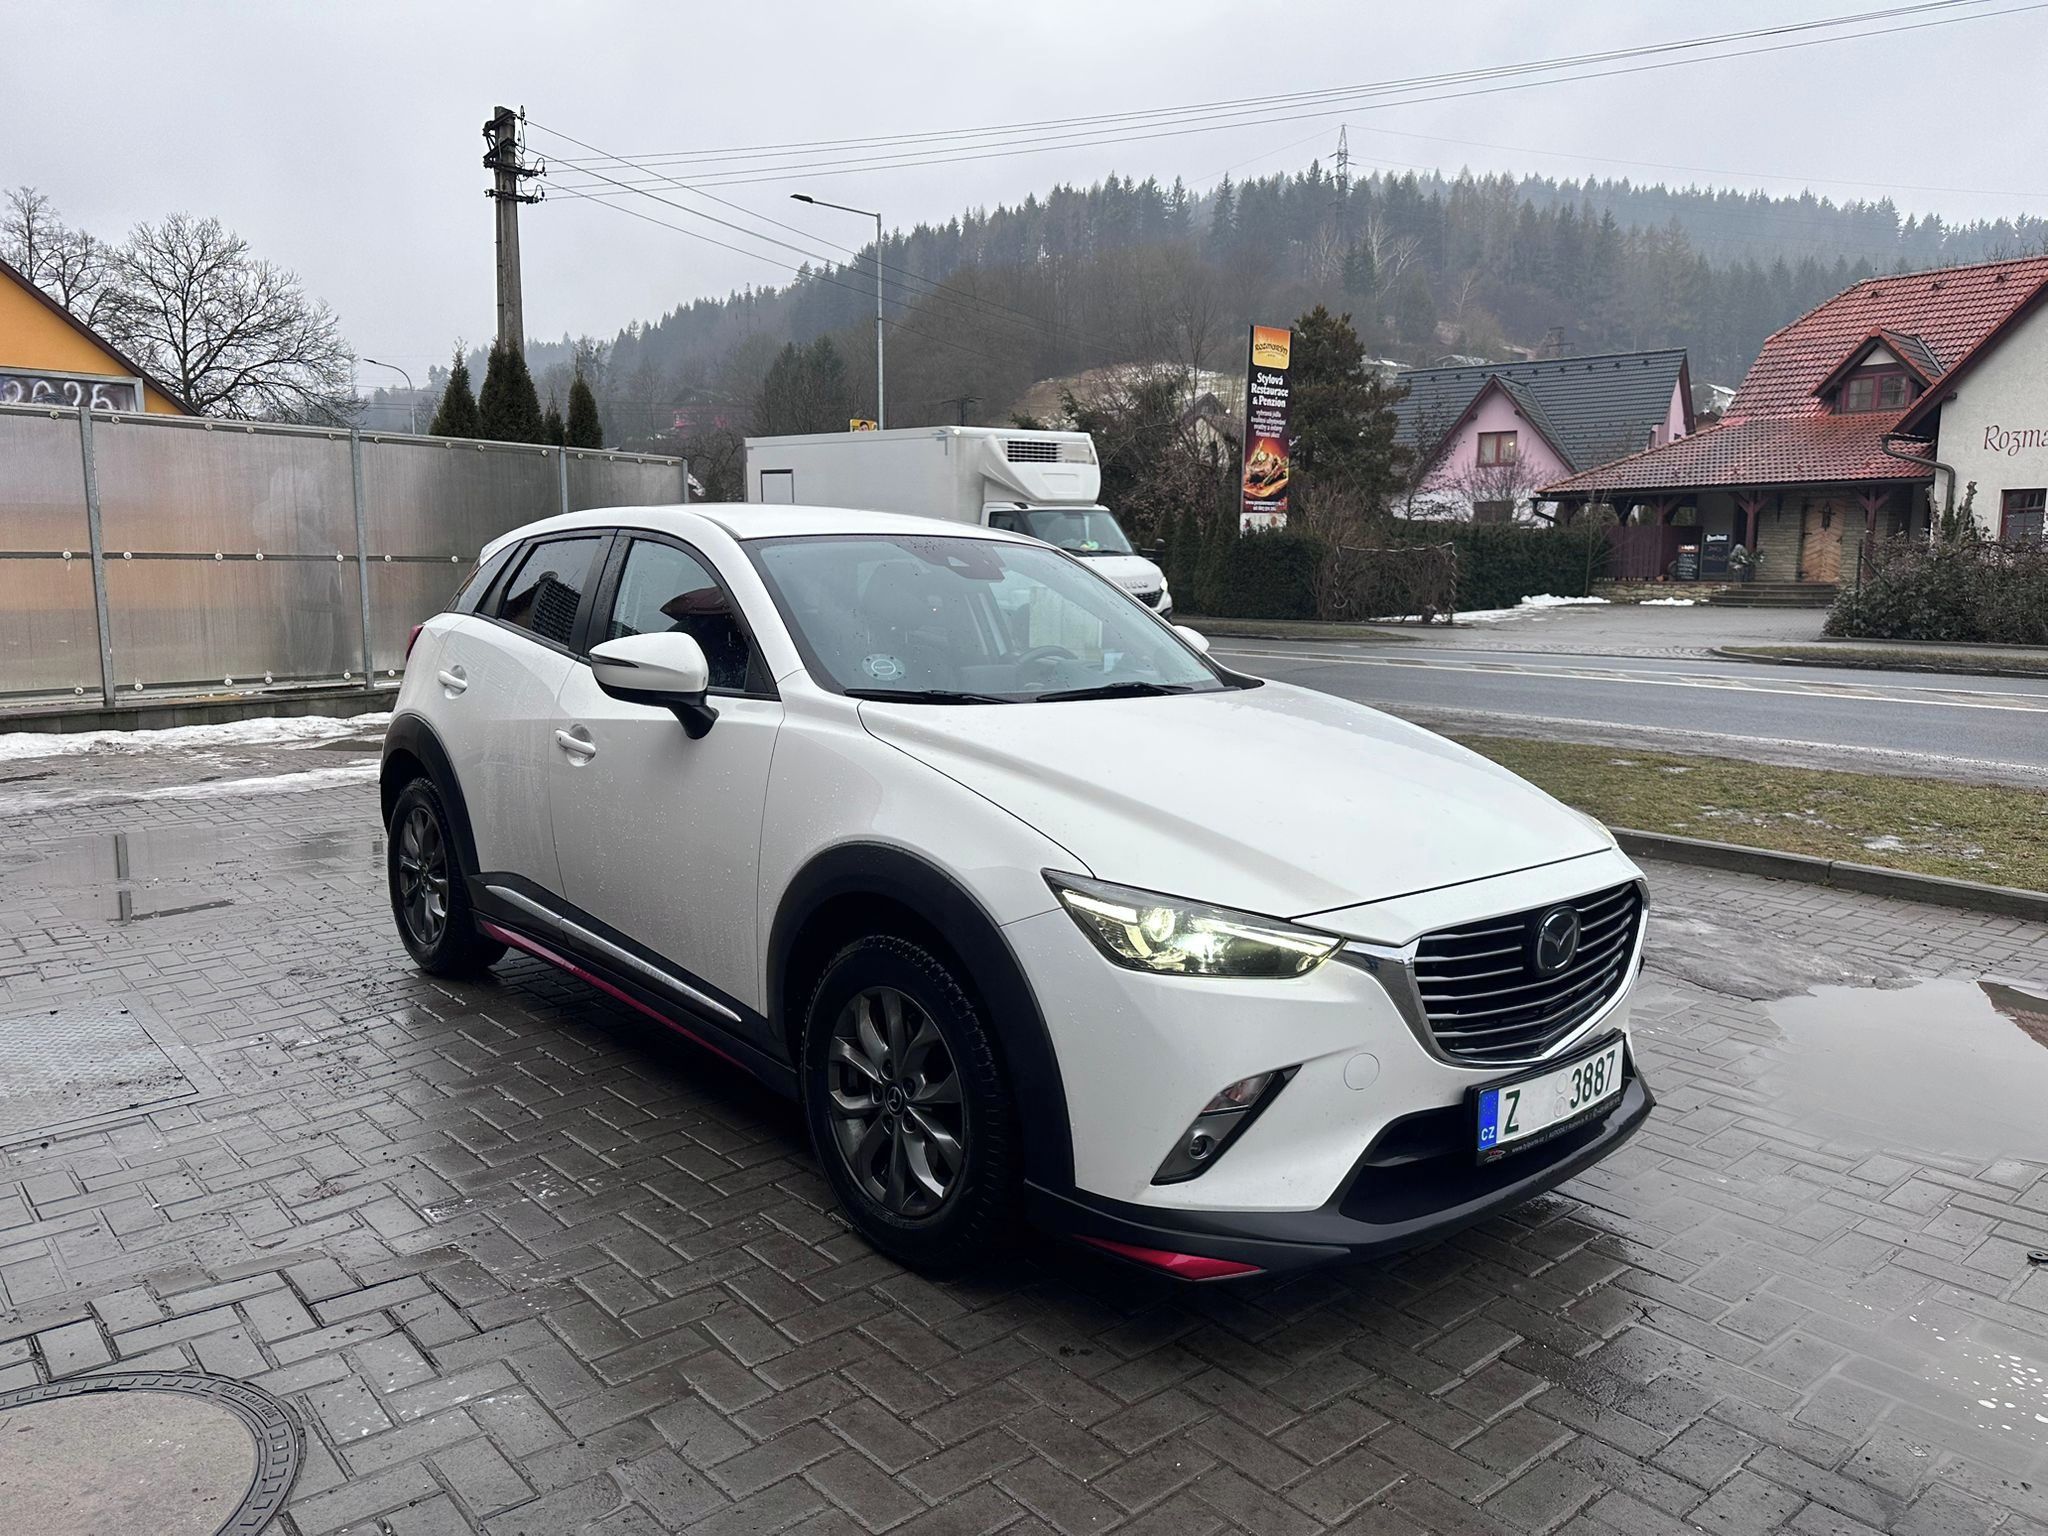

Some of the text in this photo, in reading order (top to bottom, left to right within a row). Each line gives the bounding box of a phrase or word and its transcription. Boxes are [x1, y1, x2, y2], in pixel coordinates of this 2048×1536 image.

[1257, 372, 1283, 385] Stylová
[1251, 383, 1288, 397] Restaurace
[1259, 395, 1286, 408] Penzion
[1504, 1089, 1521, 1135] Z
[1570, 1050, 1615, 1109] 3887
[1481, 1126, 1495, 1141] CZ
